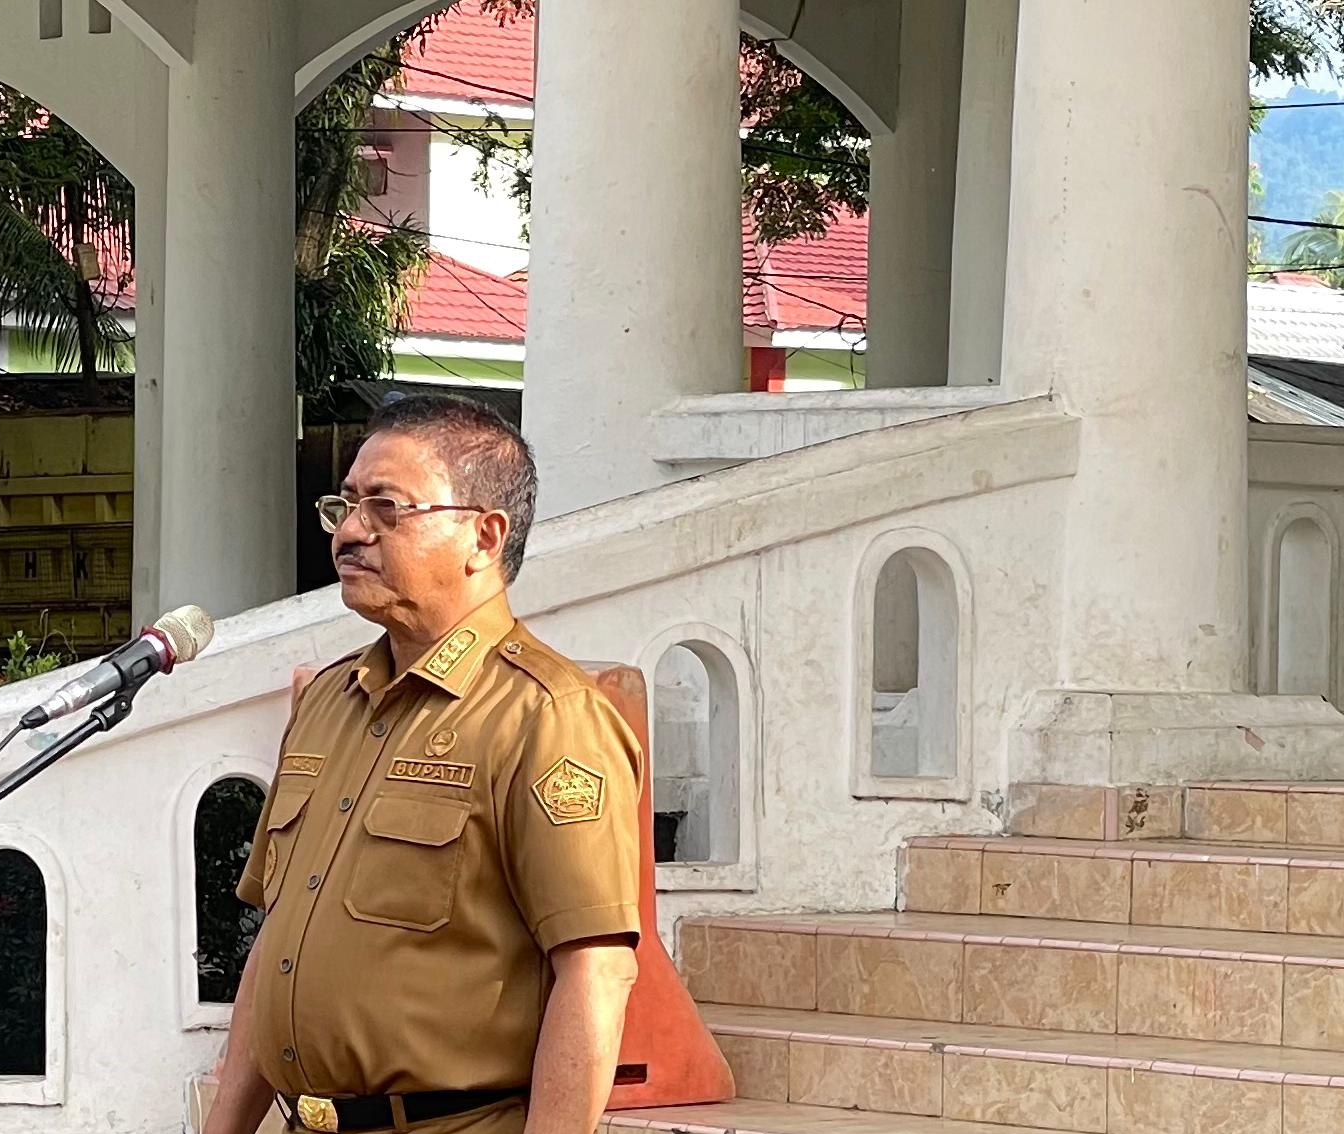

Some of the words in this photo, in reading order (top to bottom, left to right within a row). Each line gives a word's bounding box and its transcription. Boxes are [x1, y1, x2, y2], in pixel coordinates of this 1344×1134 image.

[24, 551, 37, 578] H
[76, 551, 89, 579] K
[395, 762, 467, 782] BUPATI
